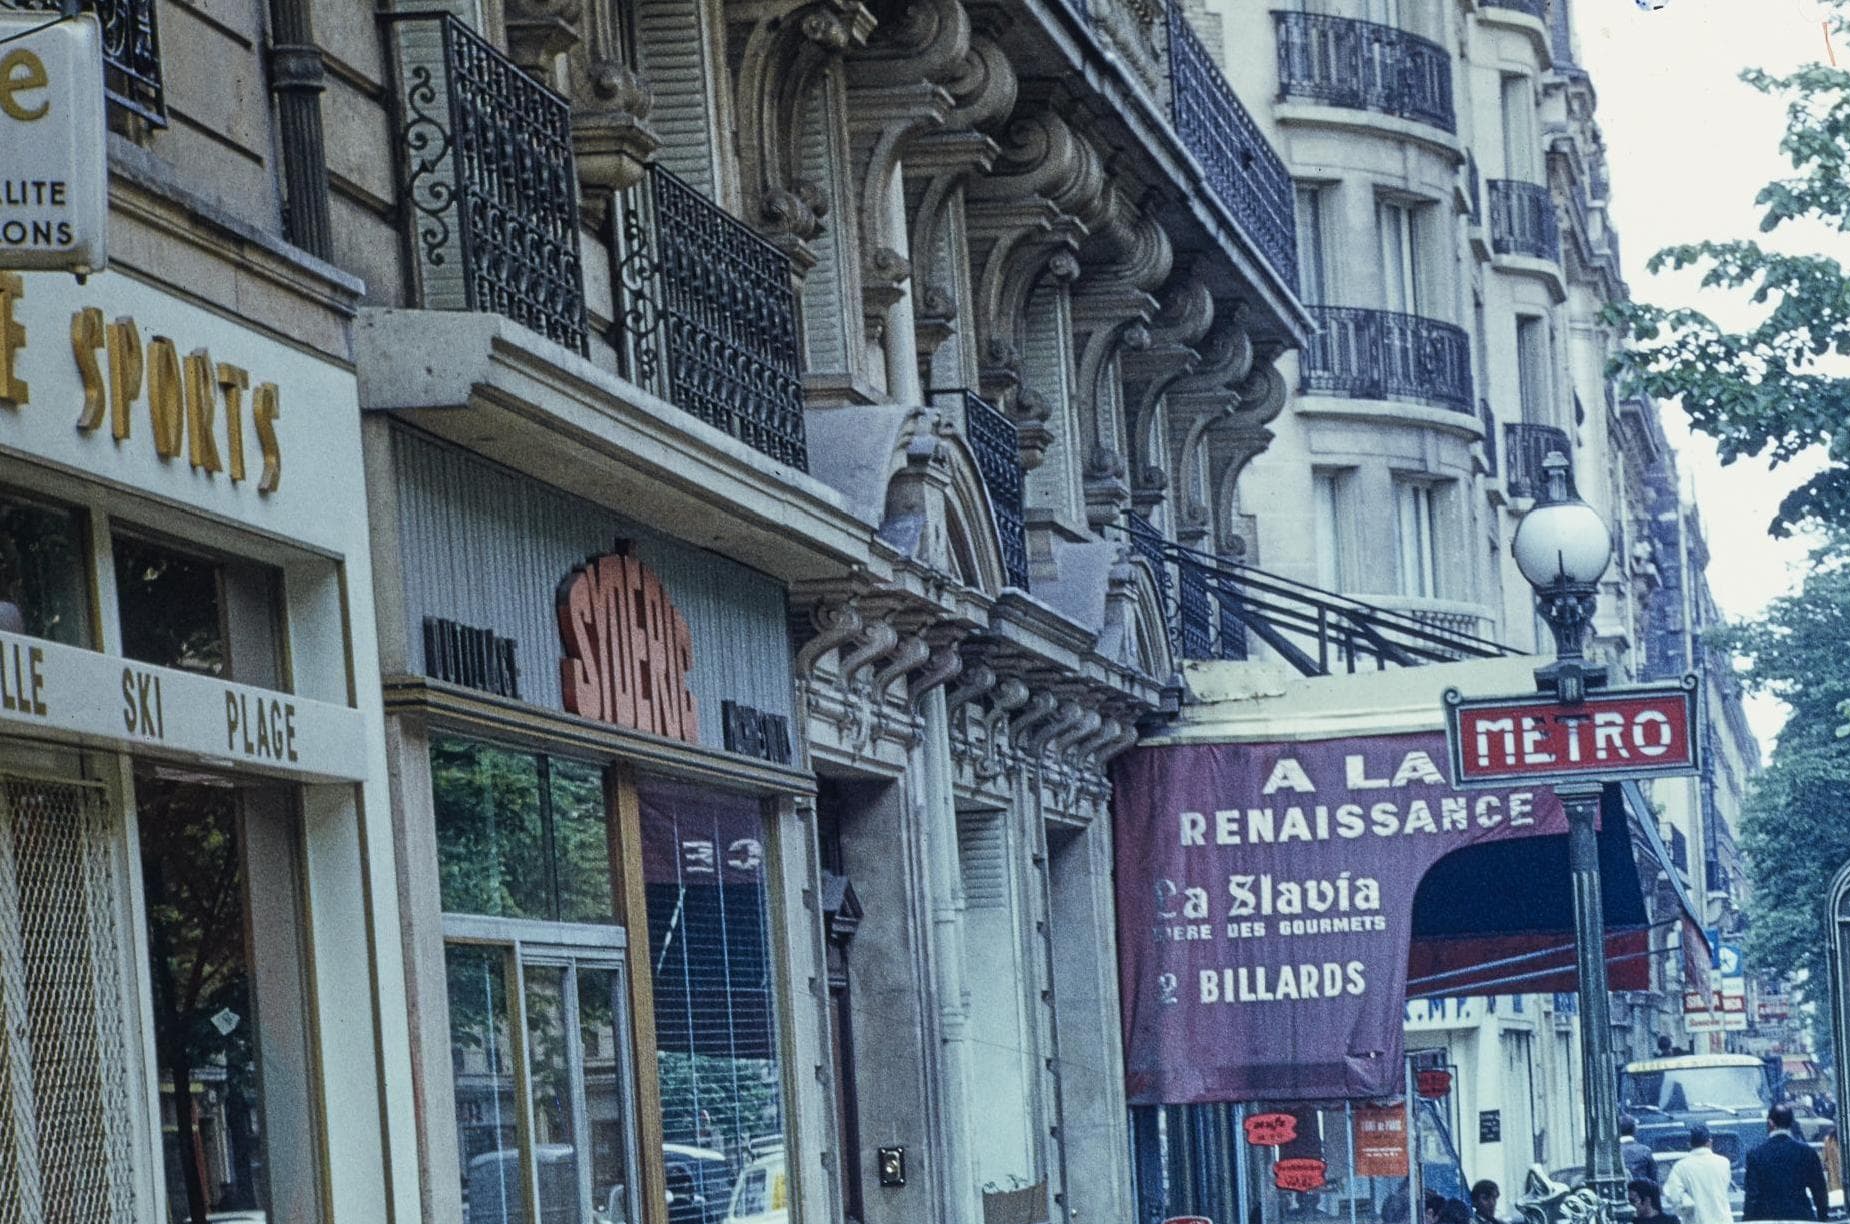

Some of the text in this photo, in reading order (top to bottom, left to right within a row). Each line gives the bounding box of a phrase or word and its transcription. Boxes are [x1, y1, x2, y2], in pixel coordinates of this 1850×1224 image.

[71, 306, 280, 494] SPORTS
[122, 667, 164, 740] SKI
[226, 690, 299, 762] PLAGE
[1476, 711, 1673, 766] METRO
[1263, 752, 1445, 794] A LA
[1181, 792, 1534, 846] RENAISSANCE
[1229, 871, 1380, 916] Slavia
[1227, 922, 1266, 938] DES
[1279, 916, 1386, 935] GOURMETS
[1201, 961, 1365, 1003] BILLARDS
